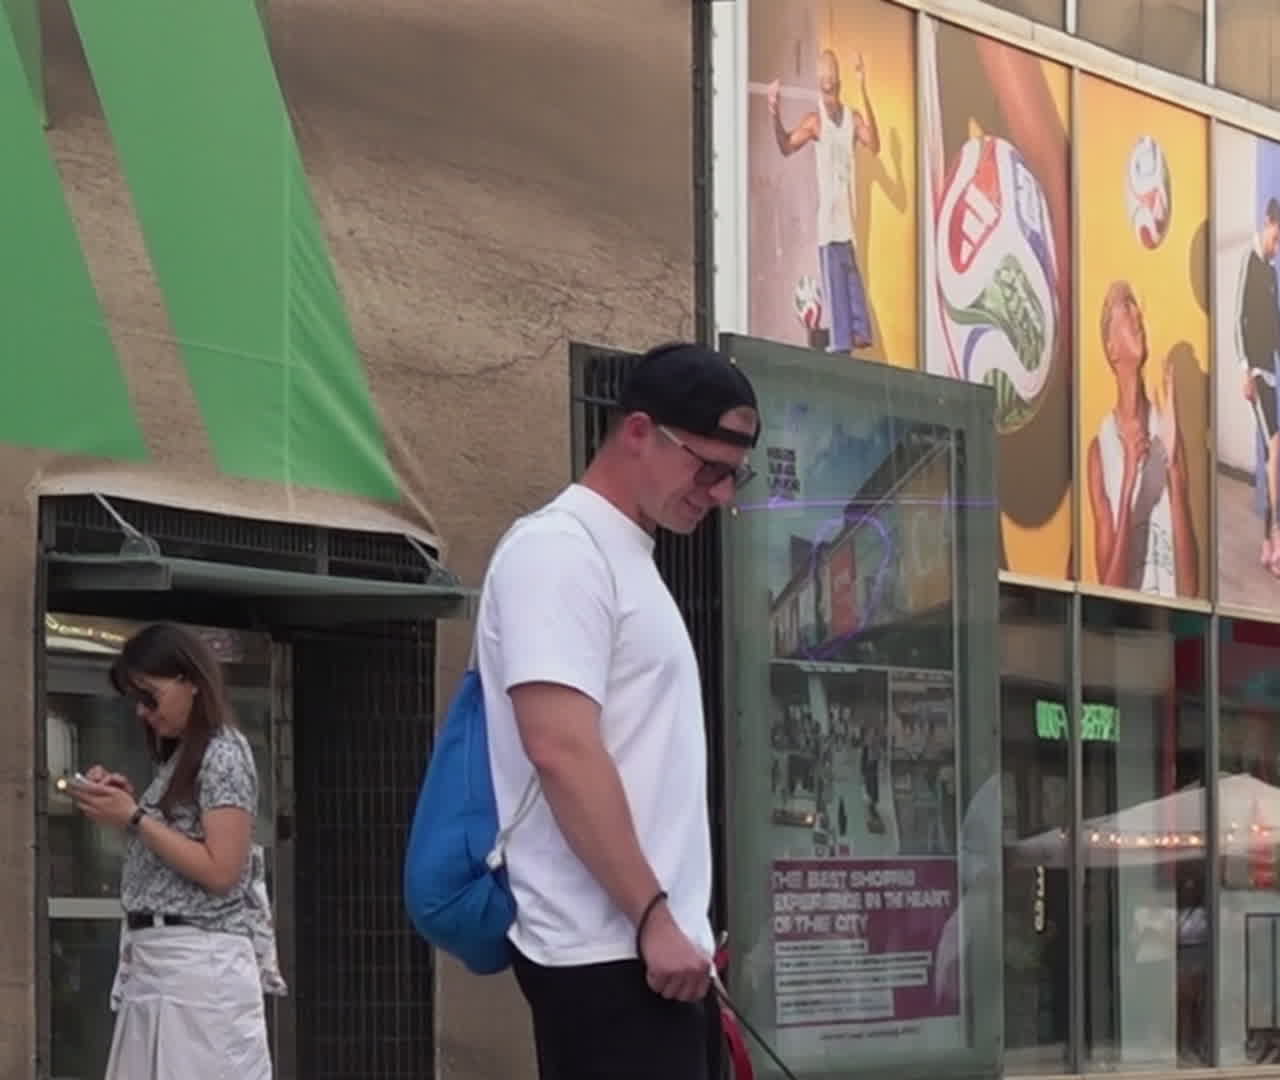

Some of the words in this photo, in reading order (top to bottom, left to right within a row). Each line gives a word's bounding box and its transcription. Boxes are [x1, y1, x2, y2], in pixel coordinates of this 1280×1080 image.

[771, 871, 801, 888] THE
[807, 870, 848, 888] BEST
[864, 892, 882, 909] IN
[905, 890, 951, 907] HEART
[774, 915, 793, 934] OF
[795, 914, 831, 933] THE
[836, 913, 868, 932] CITY
